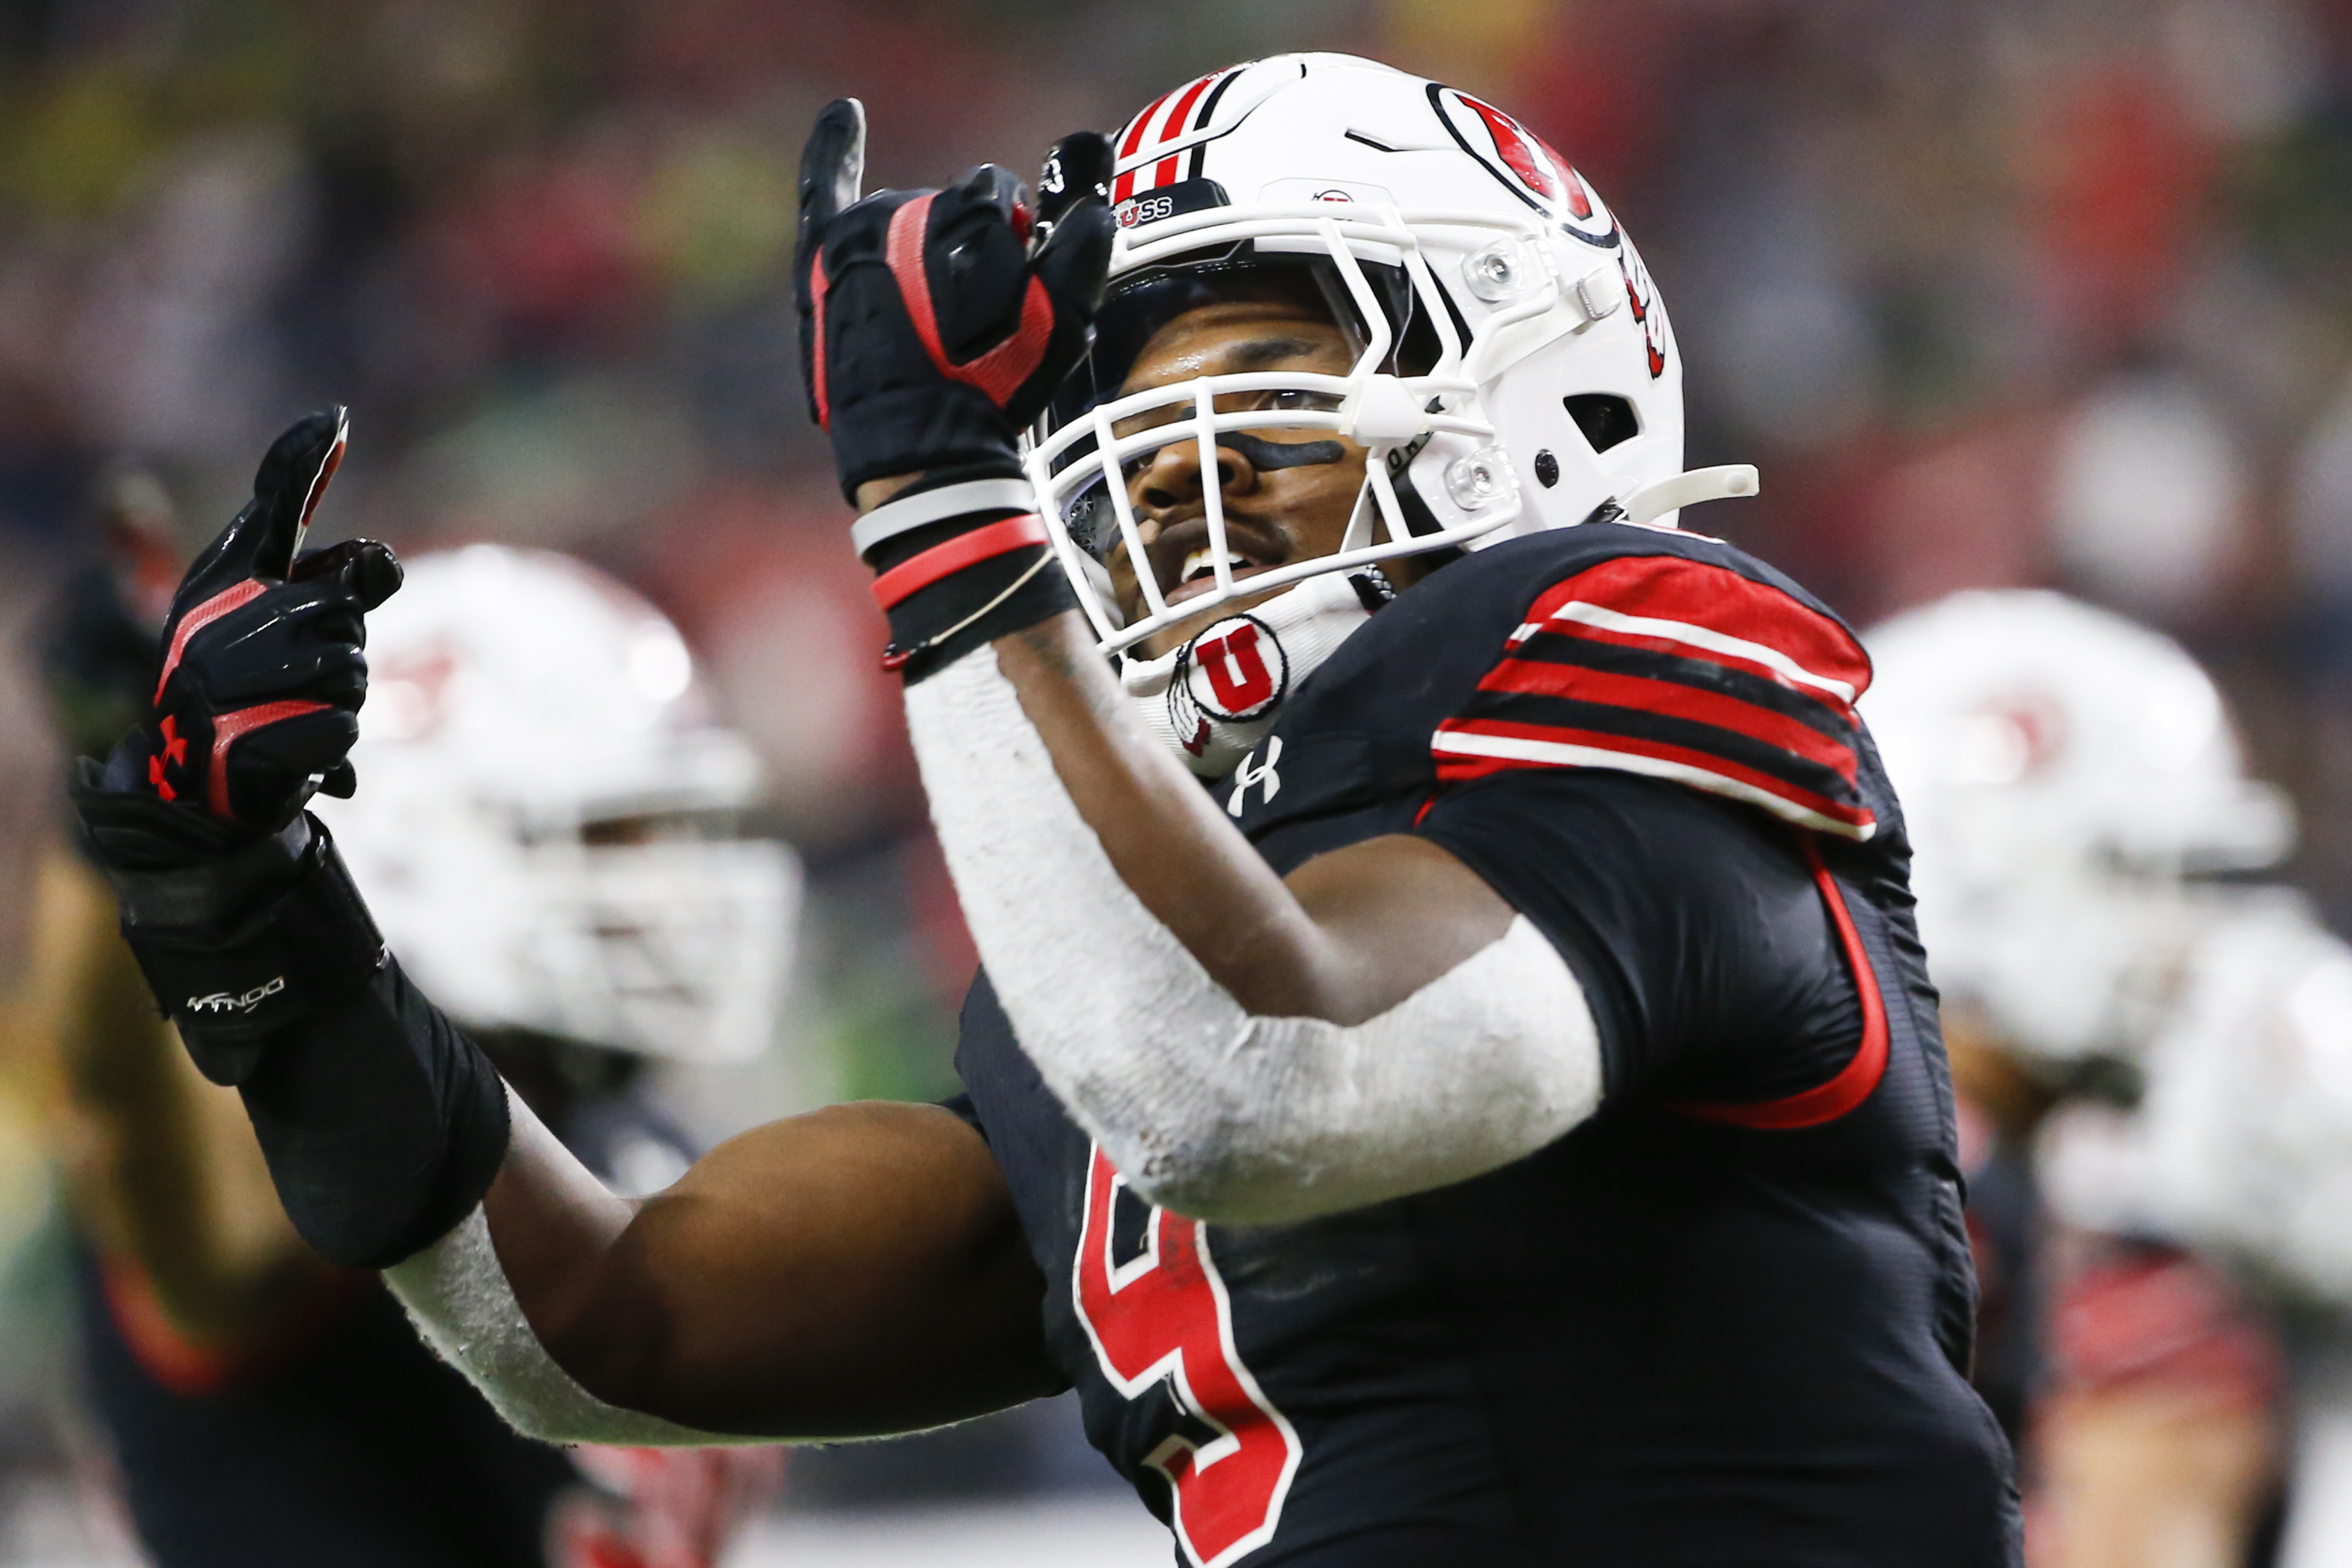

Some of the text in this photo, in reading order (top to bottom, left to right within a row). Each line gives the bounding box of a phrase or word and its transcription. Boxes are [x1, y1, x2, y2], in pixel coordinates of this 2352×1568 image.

[1115, 197, 1172, 227] USS
[1195, 623, 1272, 714] U
[1073, 1138, 1303, 1568] 9
